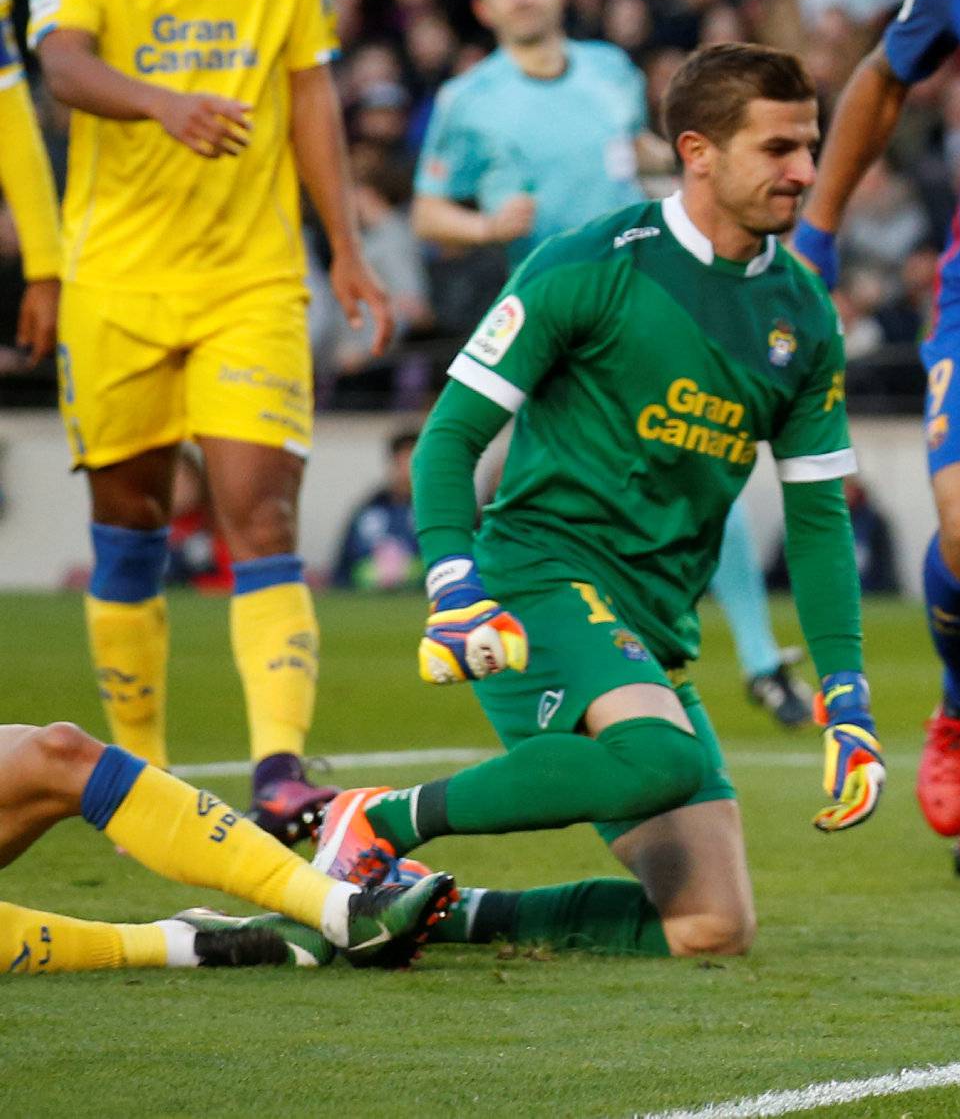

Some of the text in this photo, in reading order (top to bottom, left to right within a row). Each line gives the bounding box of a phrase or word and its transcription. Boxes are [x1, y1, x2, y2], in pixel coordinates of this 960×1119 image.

[152, 13, 236, 42] Gran
[667, 377, 744, 428] Gran
[928, 357, 954, 417] 9
[637, 404, 757, 464] Canaria
